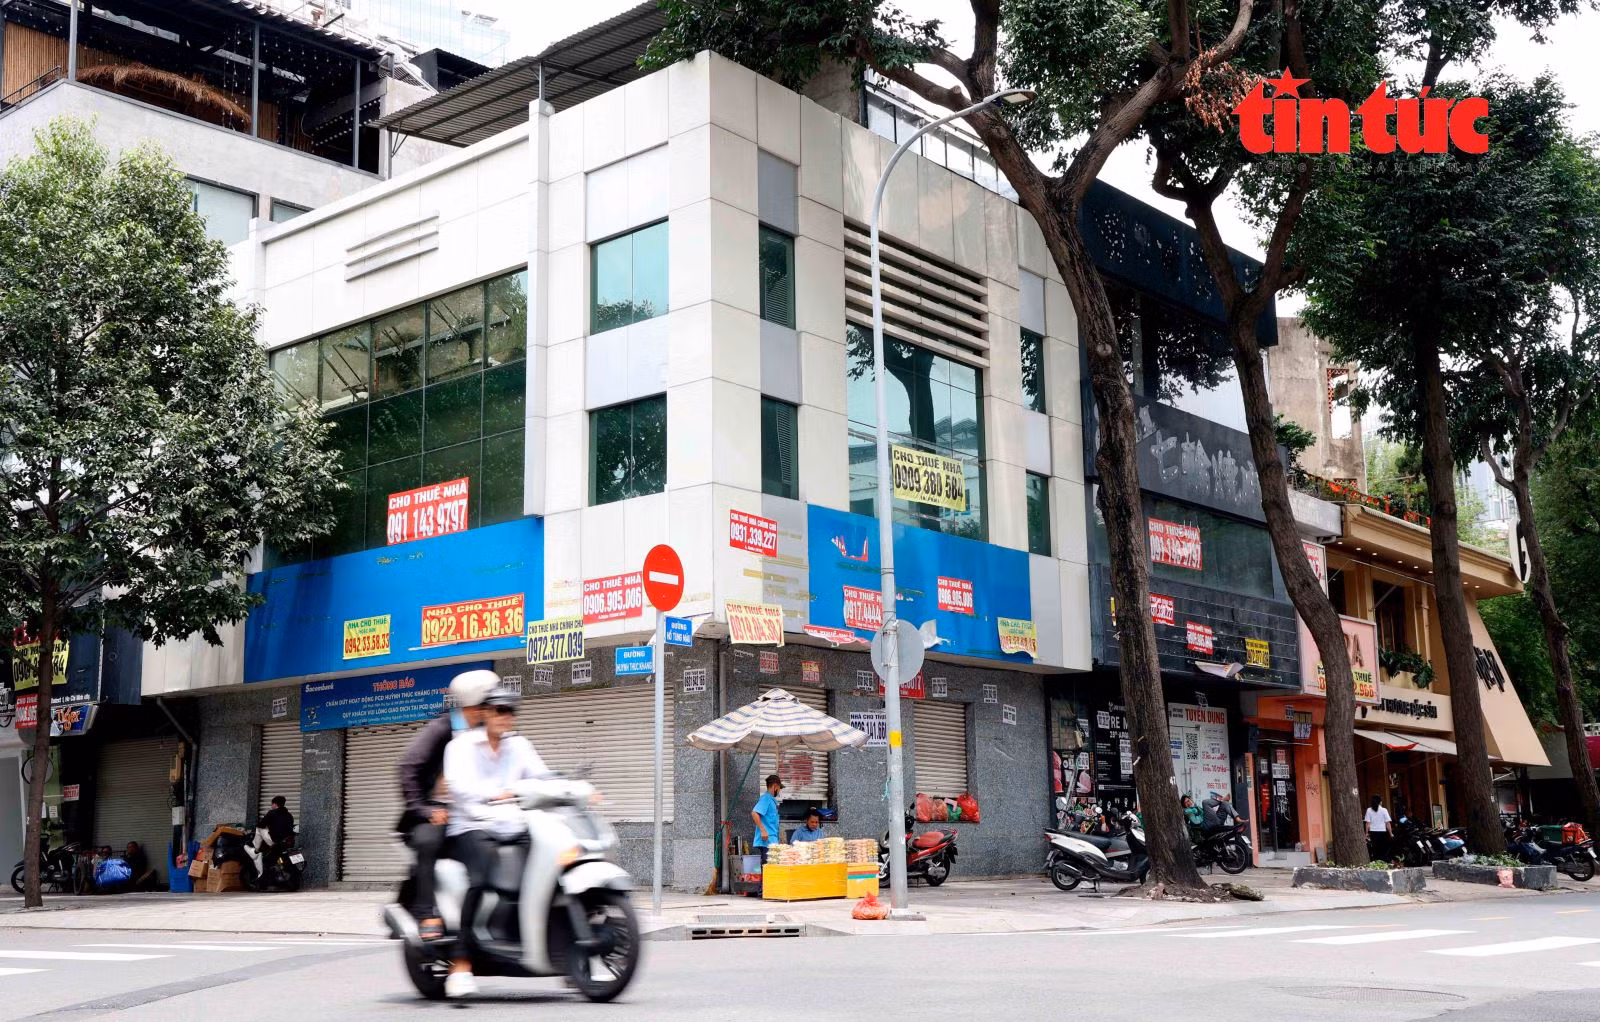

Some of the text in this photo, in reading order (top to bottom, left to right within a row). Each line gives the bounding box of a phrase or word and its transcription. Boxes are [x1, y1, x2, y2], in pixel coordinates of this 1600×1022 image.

[893, 450, 913, 463] CHO
[918, 456, 940, 472] THUÊ
[895, 464, 963, 502] 0909 380 584
[389, 480, 467, 509] CHO THUÊ NHÀ
[389, 500, 467, 543] 091 143 9797
[1149, 521, 1164, 533] CHO
[731, 521, 777, 550] 0931.339.227
[584, 574, 641, 591] CHO THUÊ NHÀ
[938, 579, 949, 587] CHO
[950, 580, 962, 589] THUÊ
[584, 586, 642, 616] 0906.905.006
[845, 590, 858, 600] CHO
[456, 602, 482, 613] CHO
[484, 596, 519, 609] THUÊ
[727, 603, 742, 612] CHO
[845, 601, 882, 622] 0917.4444
[360, 620, 372, 628] CHO
[373, 617, 387, 626] THUÊ
[424, 607, 523, 643] 0922.16.36.36
[528, 632, 583, 662] 0972.377.039
[624, 650, 646, 659] ĐƯỜNG
[306, 682, 334, 693] Sacombank
[373, 676, 415, 692] THÔNG BÁO
